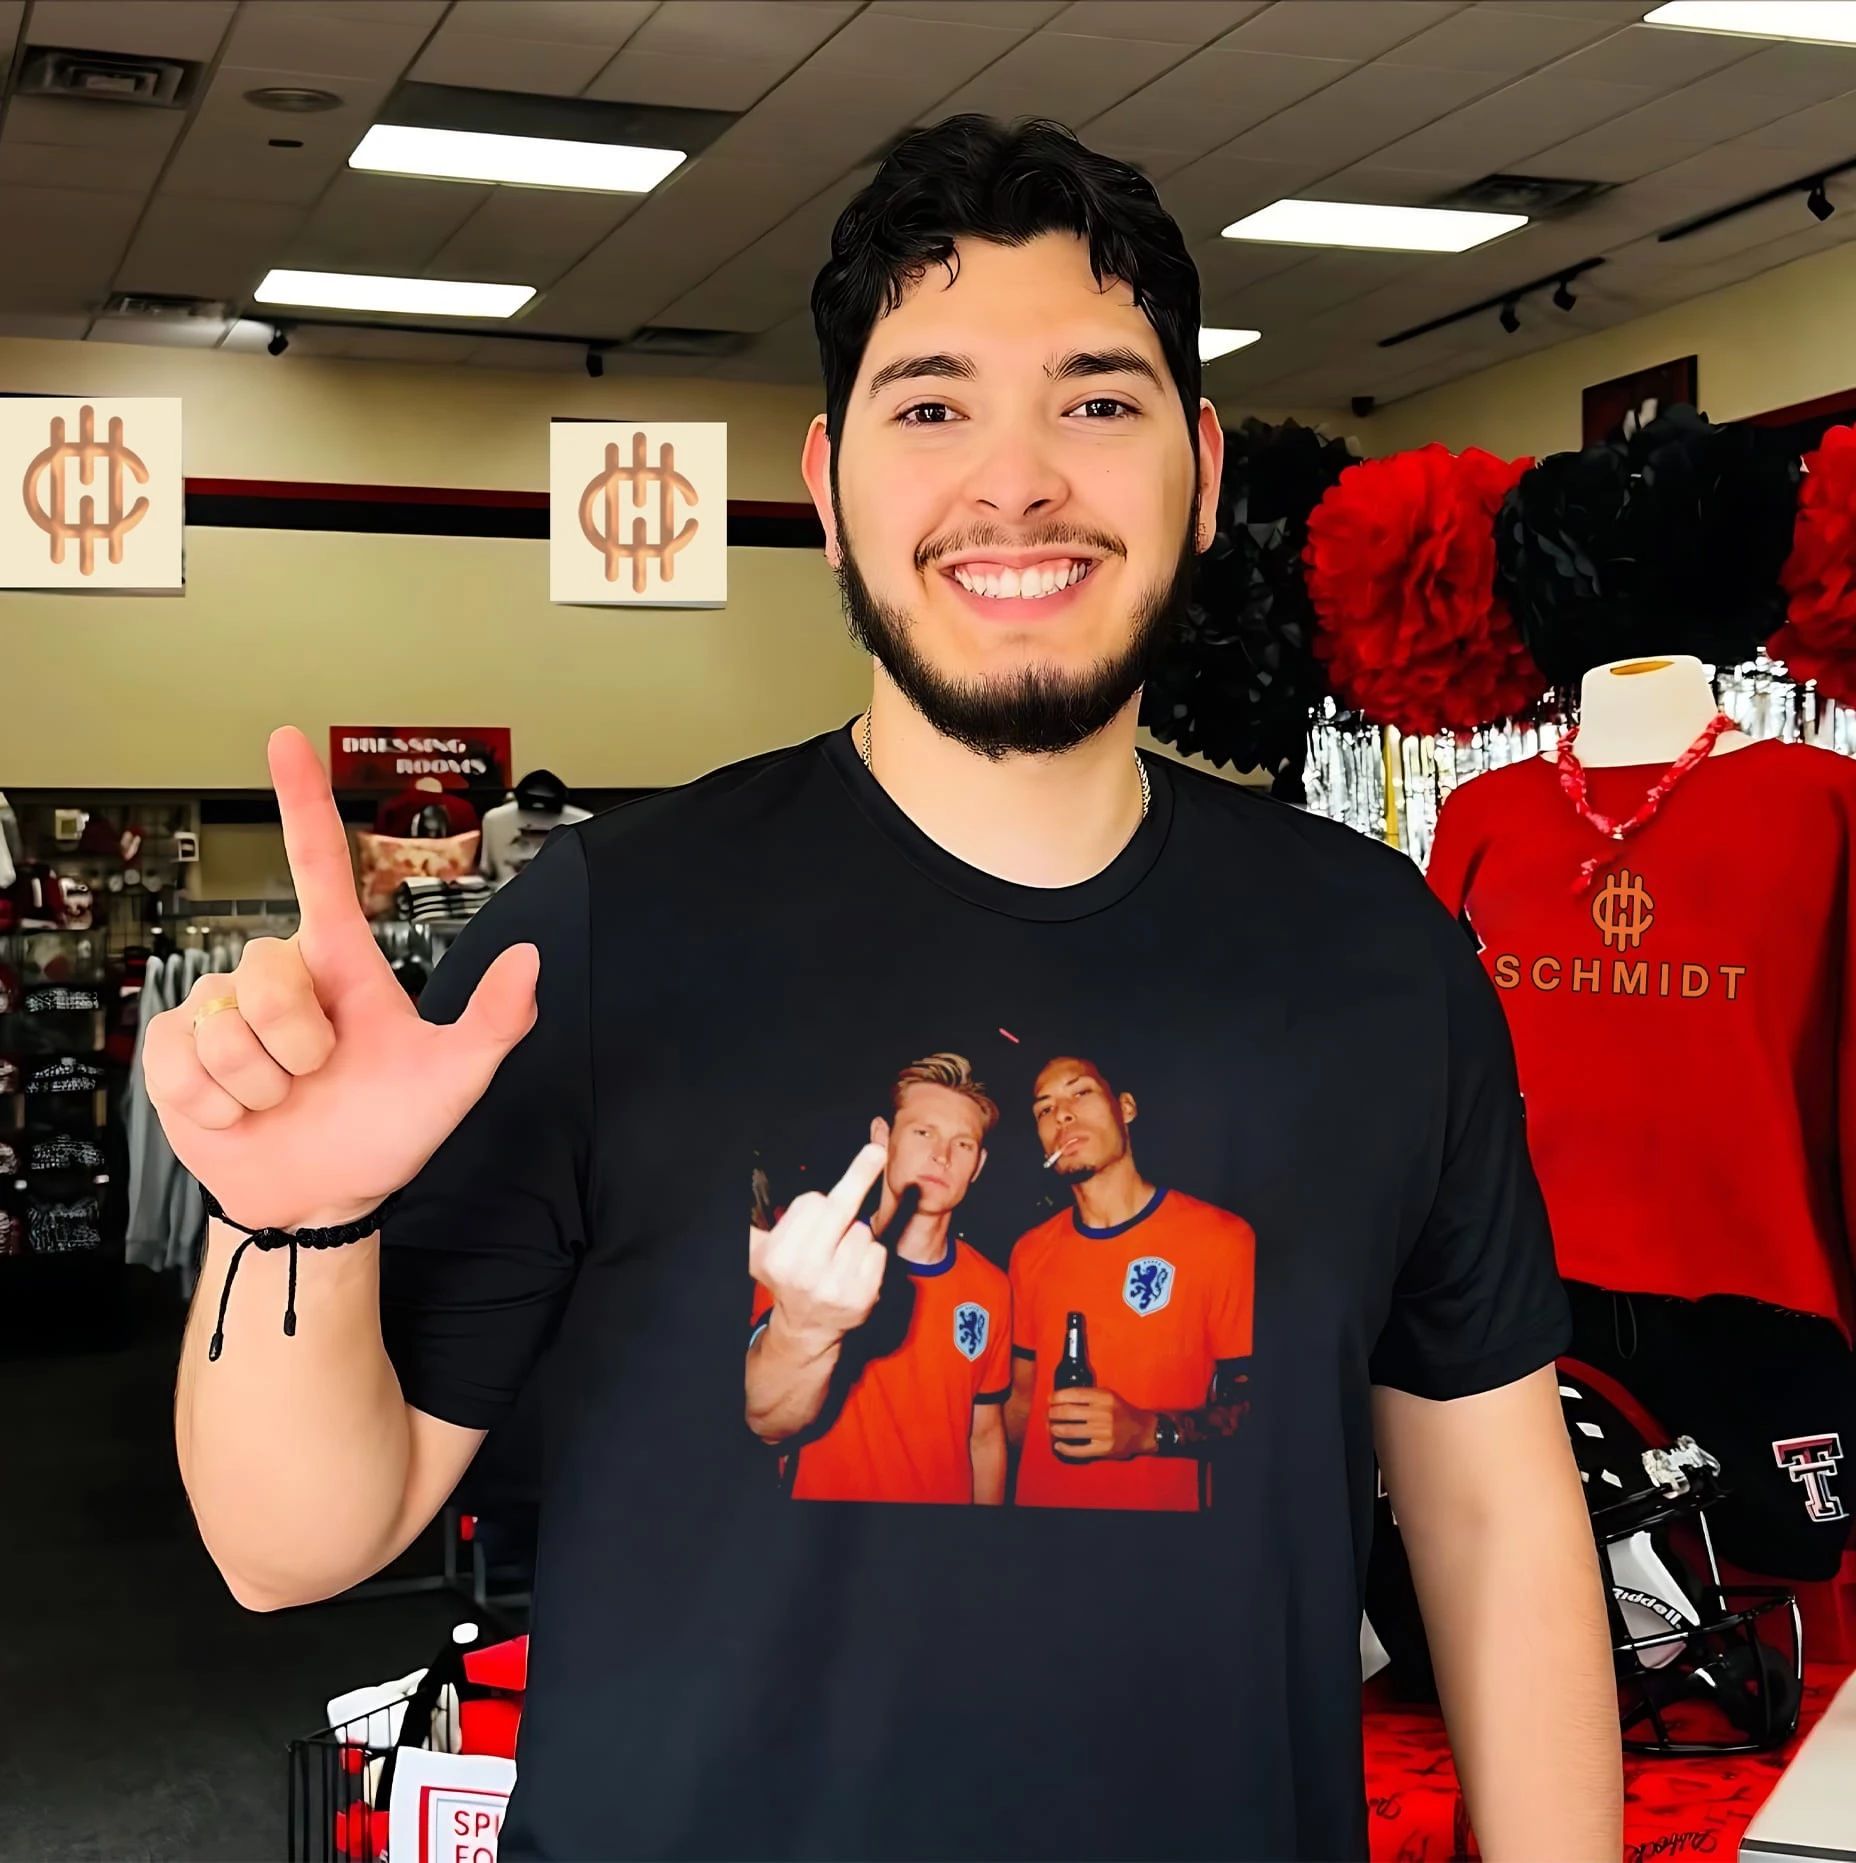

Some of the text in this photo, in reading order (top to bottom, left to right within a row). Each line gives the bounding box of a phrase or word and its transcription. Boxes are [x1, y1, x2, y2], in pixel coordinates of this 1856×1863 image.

[341, 736, 467, 754] DRESSING
[395, 757, 488, 776] ROOMS
[1493, 953, 1747, 1001] SCHMIDT
